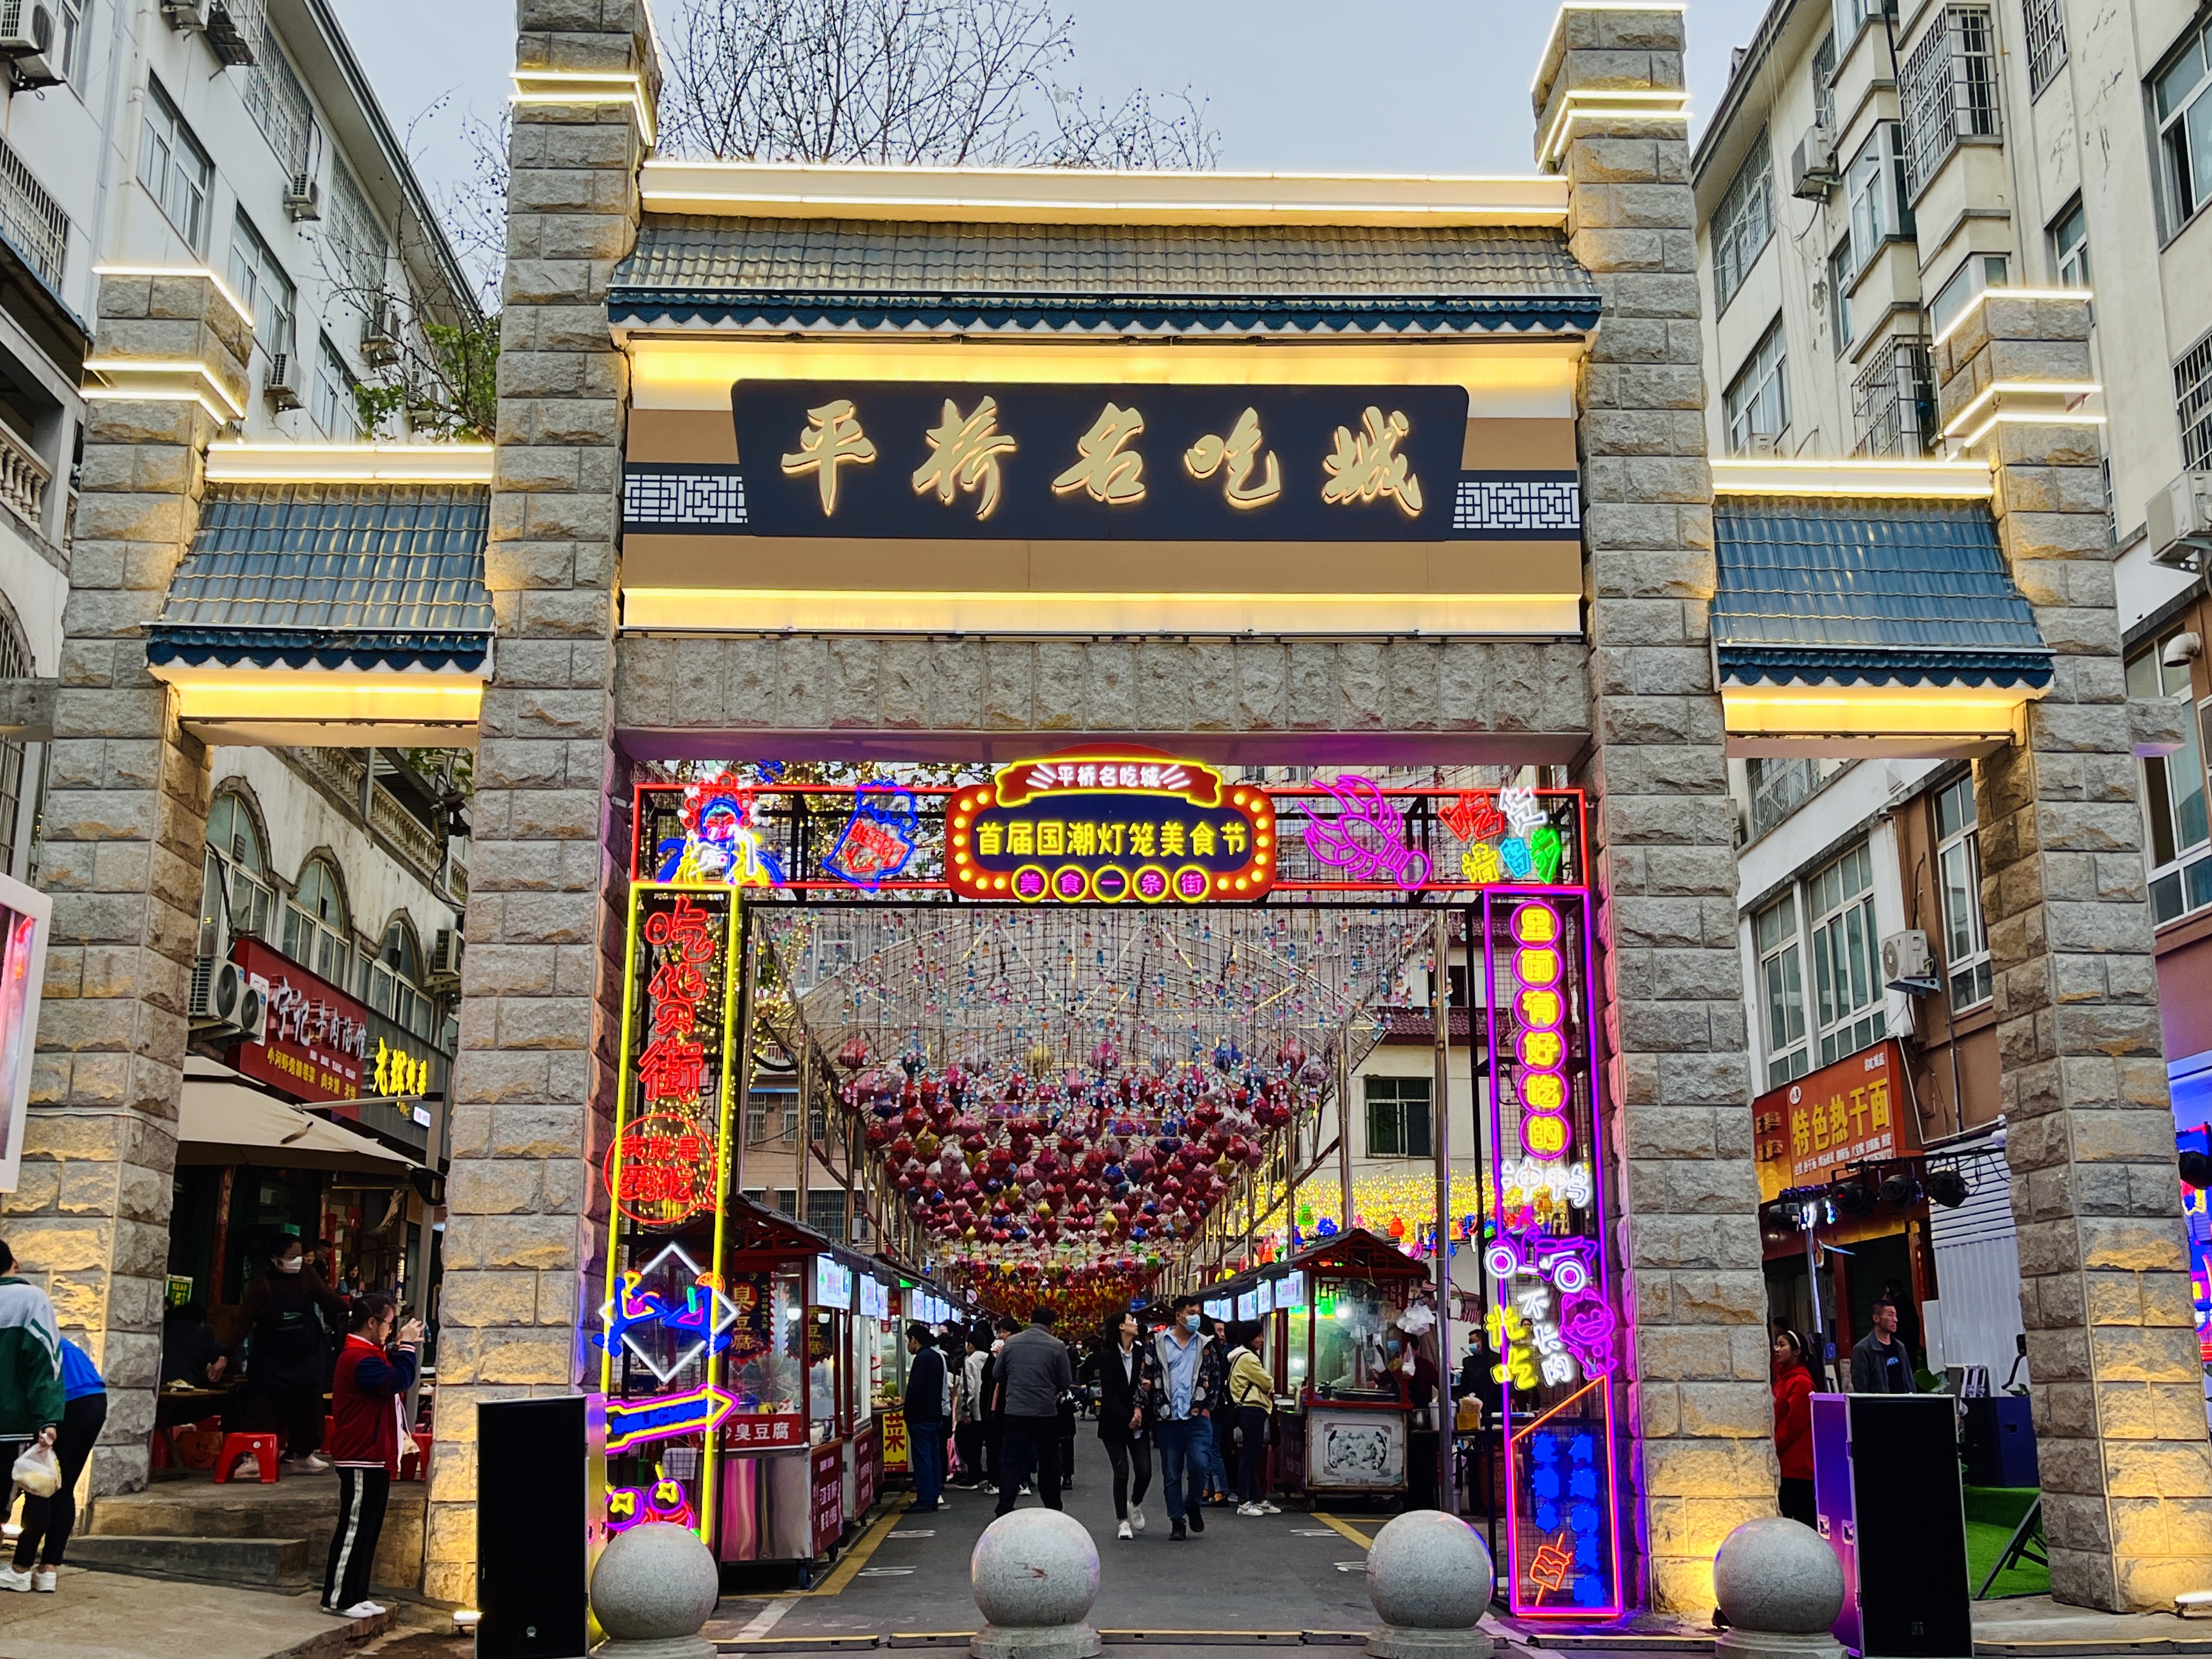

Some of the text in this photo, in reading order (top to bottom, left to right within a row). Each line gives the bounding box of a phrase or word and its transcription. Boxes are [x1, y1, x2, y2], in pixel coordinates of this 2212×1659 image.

[780, 396, 1423, 520] 平桥名吃城
[1057, 765, 1162, 787] 平桥名吃城
[976, 821, 1246, 856] 首届国潮灯笼美食节
[1019, 873, 1203, 894] 美食一条街
[639, 894, 715, 1103] 吃货街
[1520, 908, 1563, 1151] 里面有好吃的
[621, 1134, 700, 1162] 我就是
[1791, 1078, 1891, 1157] 特色热干面
[1501, 1156, 1590, 1208] 冲鸭
[732, 1285, 755, 1350] 臭豆腐
[1485, 1304, 1538, 1390] 光吃
[1517, 1289, 1572, 1387] 不长肉
